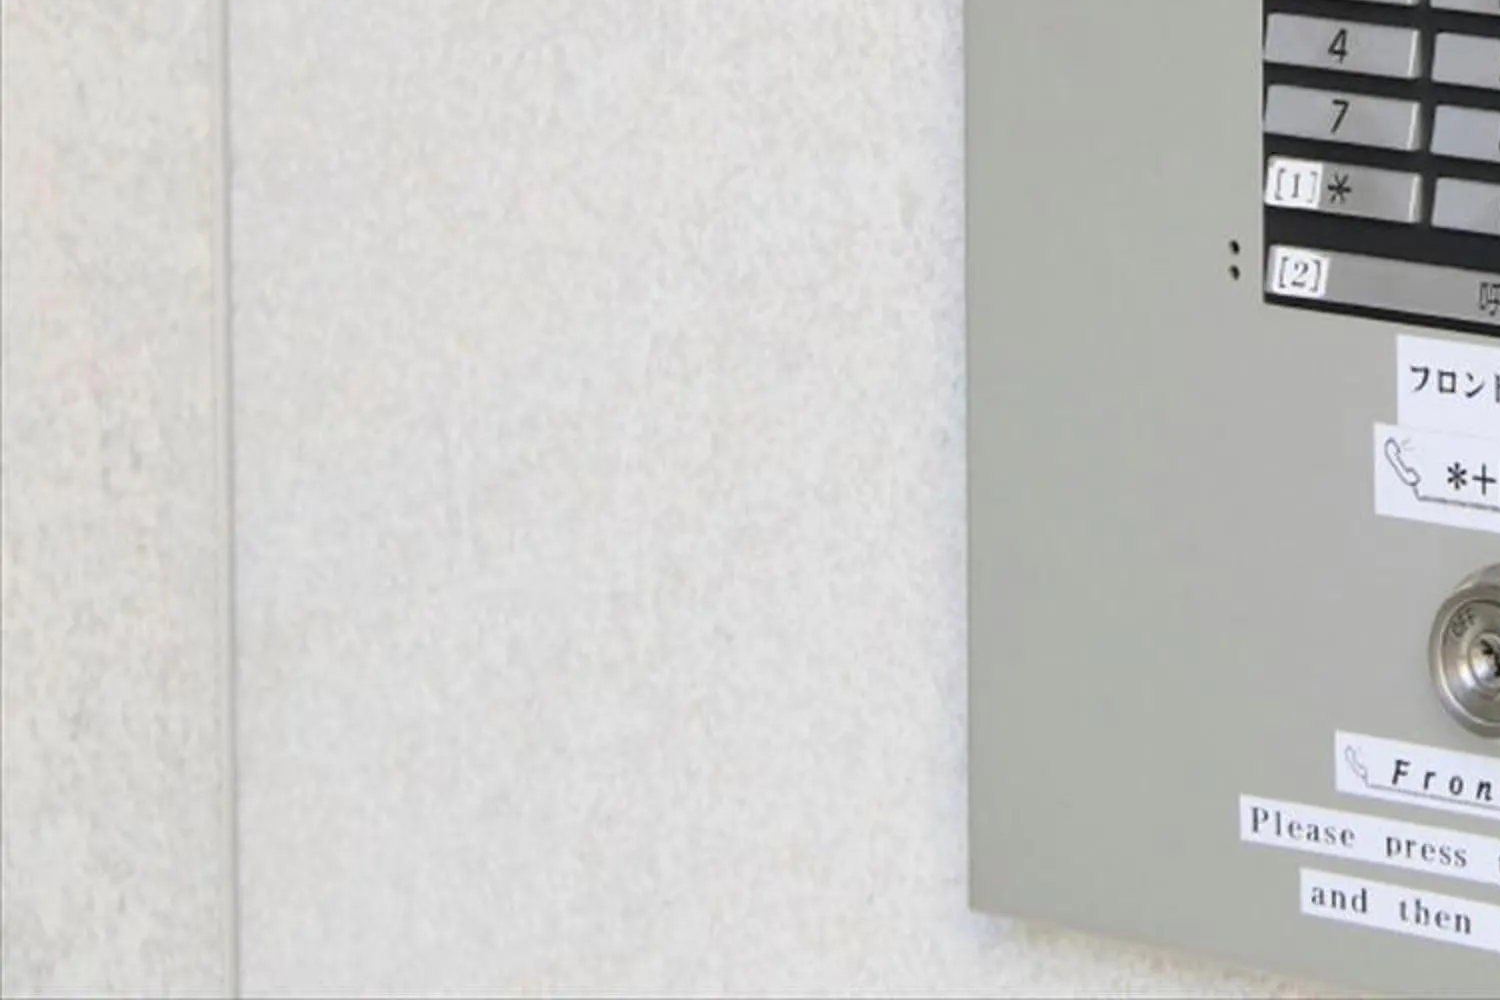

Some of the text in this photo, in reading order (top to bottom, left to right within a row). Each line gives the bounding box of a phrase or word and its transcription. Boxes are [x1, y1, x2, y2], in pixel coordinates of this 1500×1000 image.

[1327, 28, 1349, 63] 4
[1328, 99, 1349, 134] 7
[1273, 166, 1319, 203] [1]
[1275, 255, 1322, 293] [2]
[1251, 805, 1356, 848] Please
[1385, 833, 1469, 869] press
[1310, 882, 1369, 915] and
[1399, 897, 1473, 936] then
